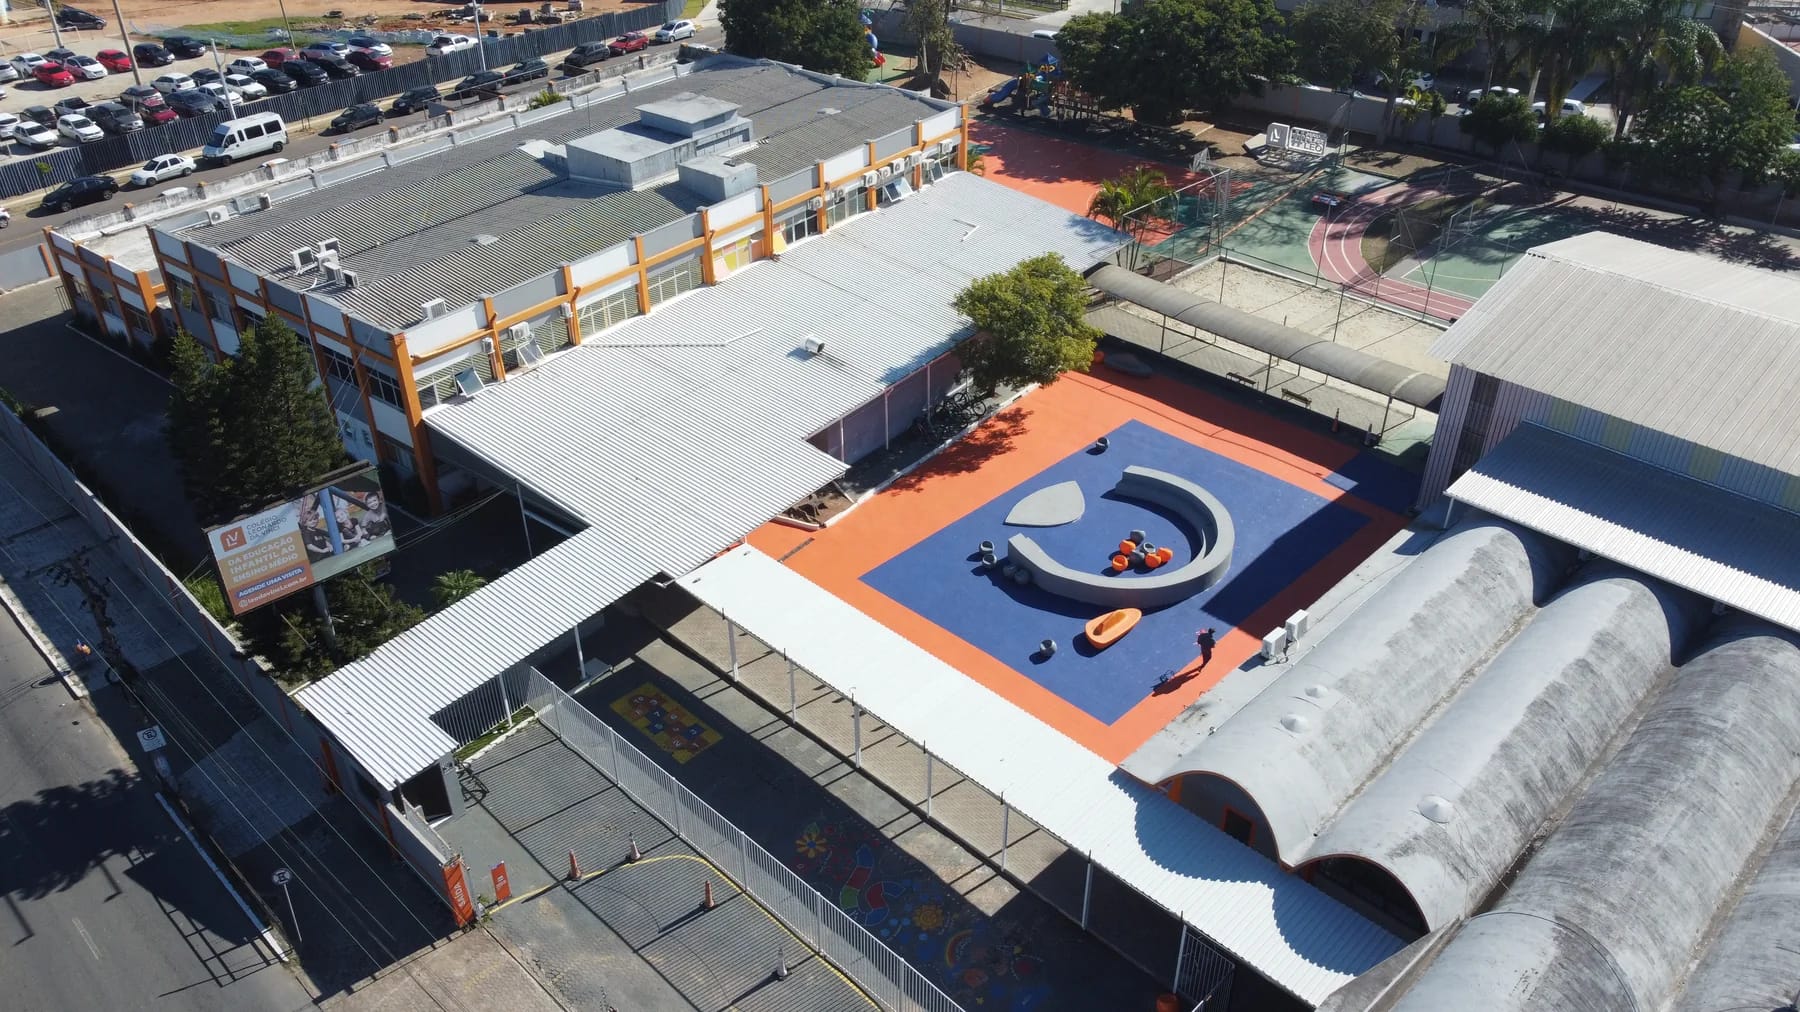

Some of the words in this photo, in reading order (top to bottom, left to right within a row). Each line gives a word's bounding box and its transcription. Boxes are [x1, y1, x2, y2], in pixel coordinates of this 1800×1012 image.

[248, 517, 288, 536] LEONARDO
[228, 557, 242, 567] DA
[230, 551, 279, 575] INFANTIL
[281, 544, 296, 557] AO
[233, 564, 268, 583] ENSINO
[269, 552, 298, 570] MÉDIO
[239, 581, 266, 598] AGENDE
[266, 575, 282, 587] UMA
[281, 567, 303, 580] VISITA
